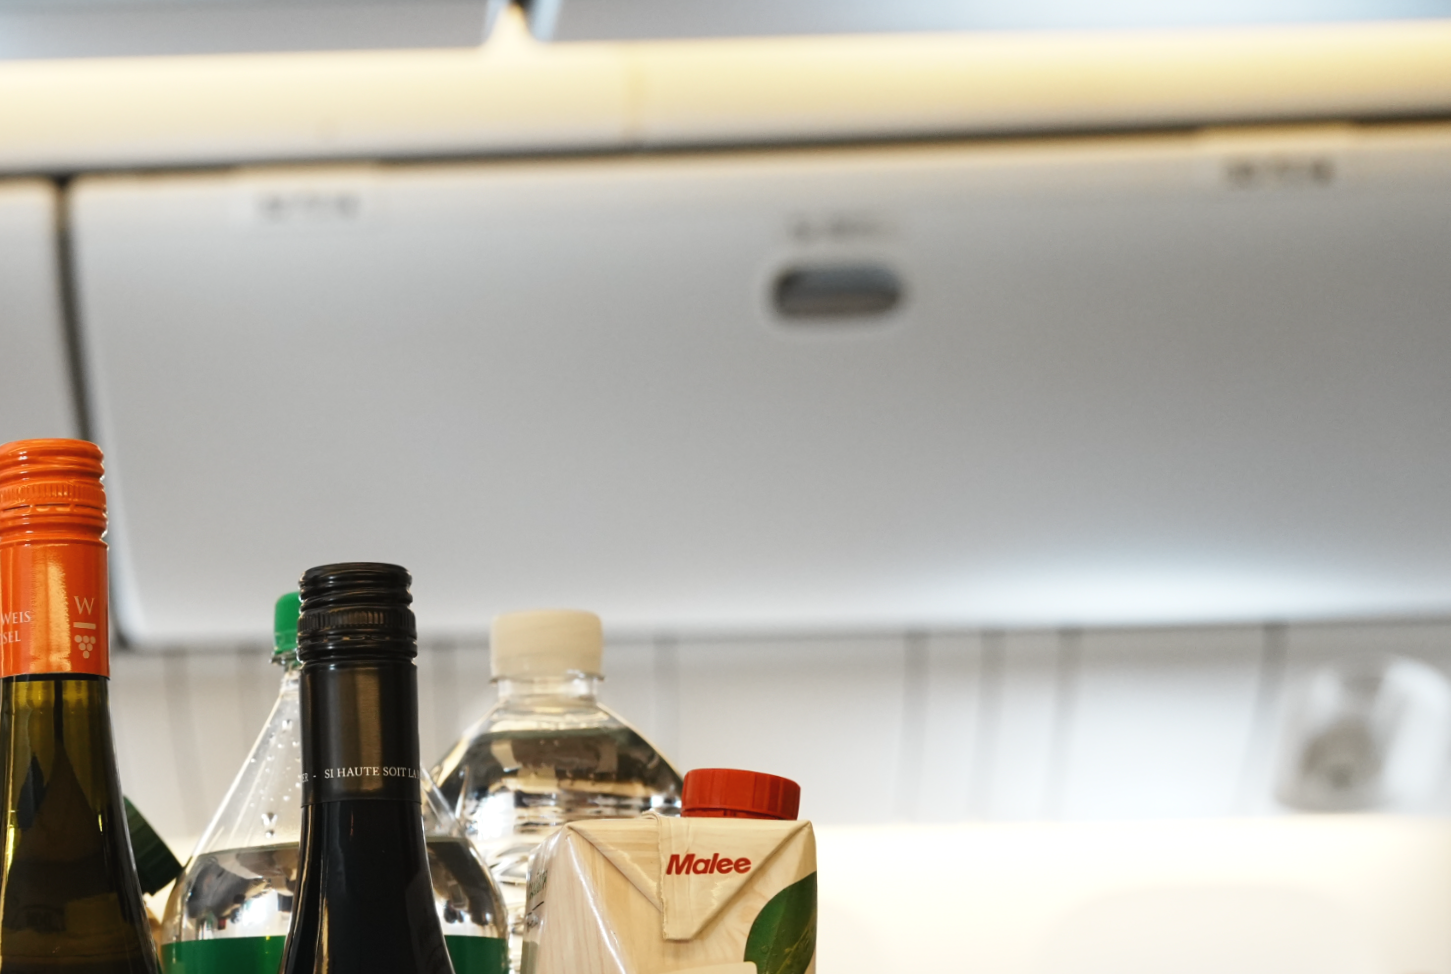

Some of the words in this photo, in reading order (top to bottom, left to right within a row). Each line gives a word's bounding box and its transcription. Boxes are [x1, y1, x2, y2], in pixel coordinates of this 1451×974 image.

[74, 596, 95, 615] W
[1, 611, 31, 625] WEIS
[325, 769, 334, 778] SI
[337, 767, 379, 777] HAUTE
[383, 767, 406, 776] SOIT
[666, 853, 751, 875] Malee
